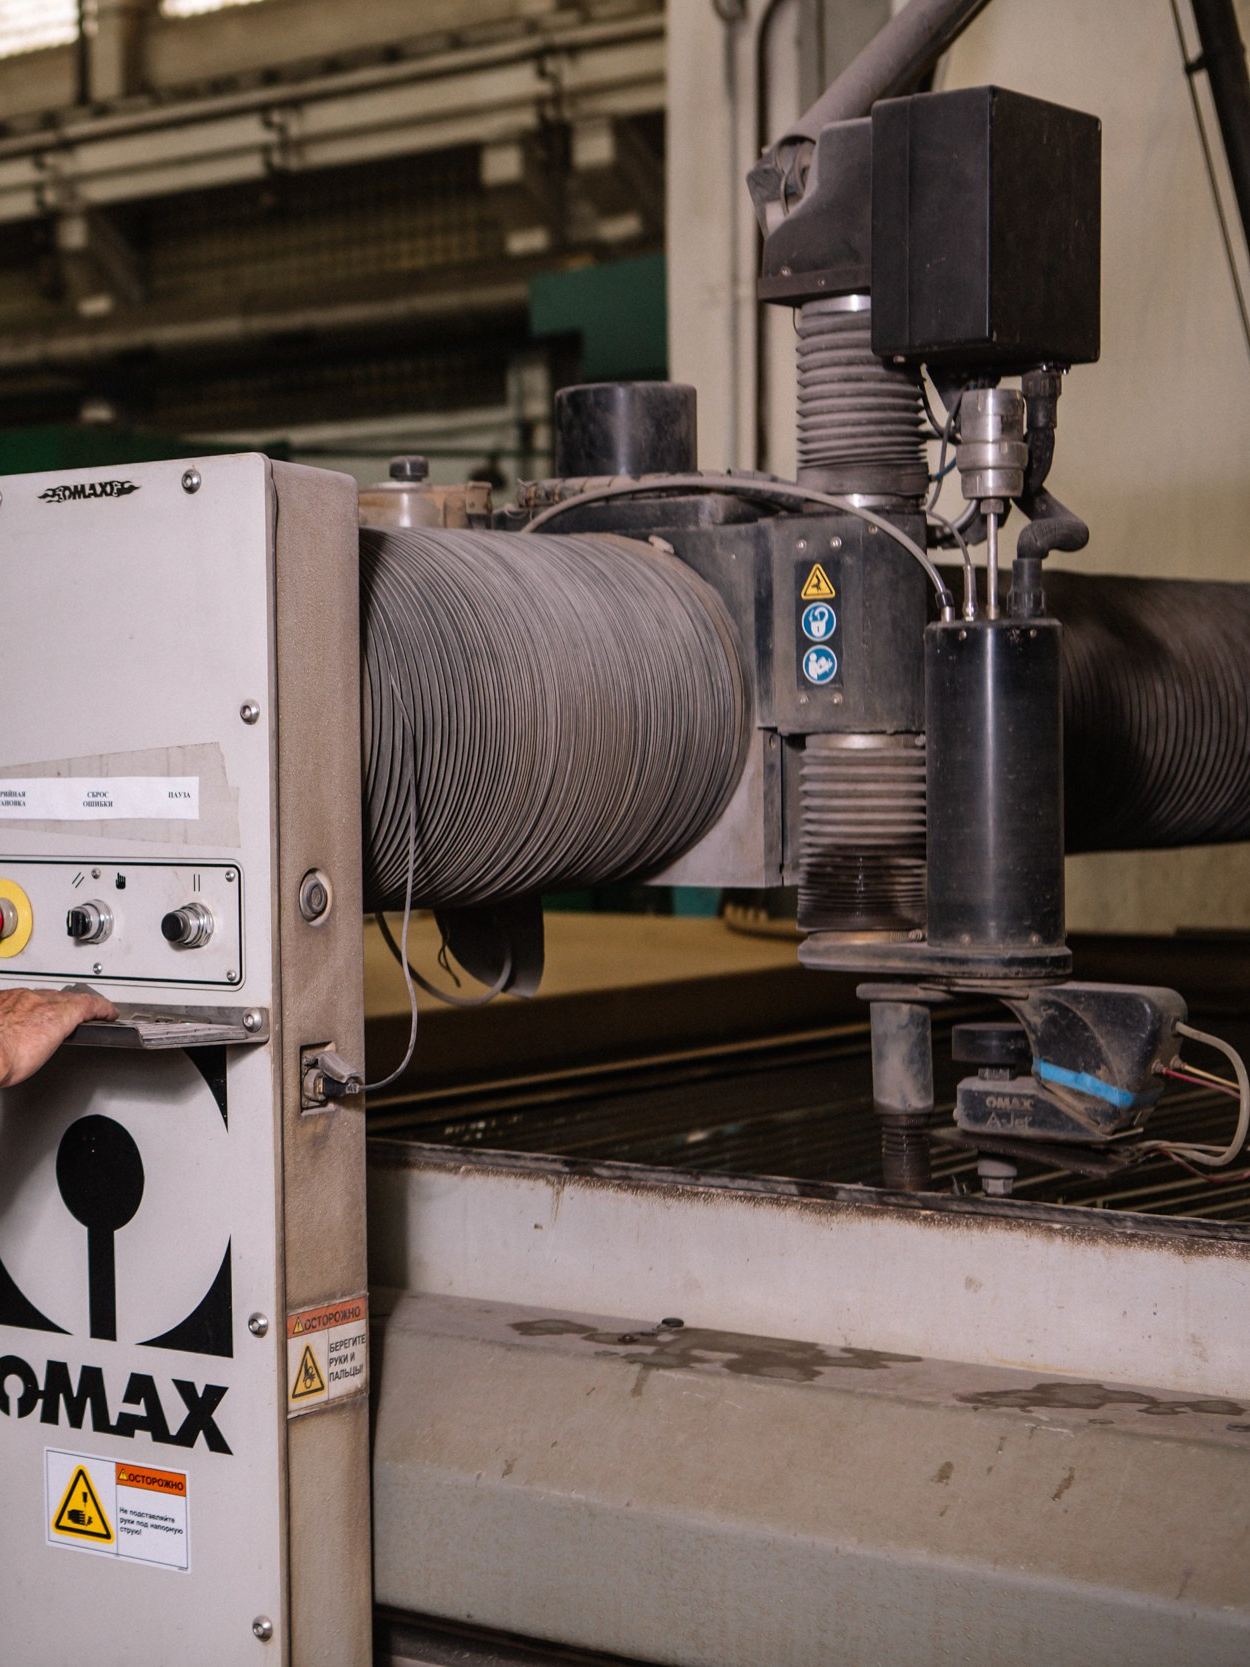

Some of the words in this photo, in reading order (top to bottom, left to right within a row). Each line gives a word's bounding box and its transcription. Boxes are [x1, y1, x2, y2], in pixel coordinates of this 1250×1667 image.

[86, 791, 109, 799] СБРОС
[168, 791, 191, 799] ПАУЗА
[82, 800, 113, 808] ОШИБКИ
[985, 1096, 1035, 1111] OMAX
[304, 1306, 361, 1331] ОСТОРОЖНО
[329, 1334, 366, 1354] БЕРЕГИТЕ
[329, 1355, 349, 1368] РУКИ
[350, 1352, 356, 1362] И
[329, 1364, 364, 1382] ПАЛЬЦЫ!
[128, 1473, 184, 1491] ОСТОРОЖНО
[119, 1506, 128, 1515] Не
[129, 1509, 175, 1523] подставляйте
[119, 1517, 135, 1527] руки
[136, 1520, 149, 1529] под
[150, 1523, 184, 1535] напорную
[119, 1526, 142, 1536] струю!
